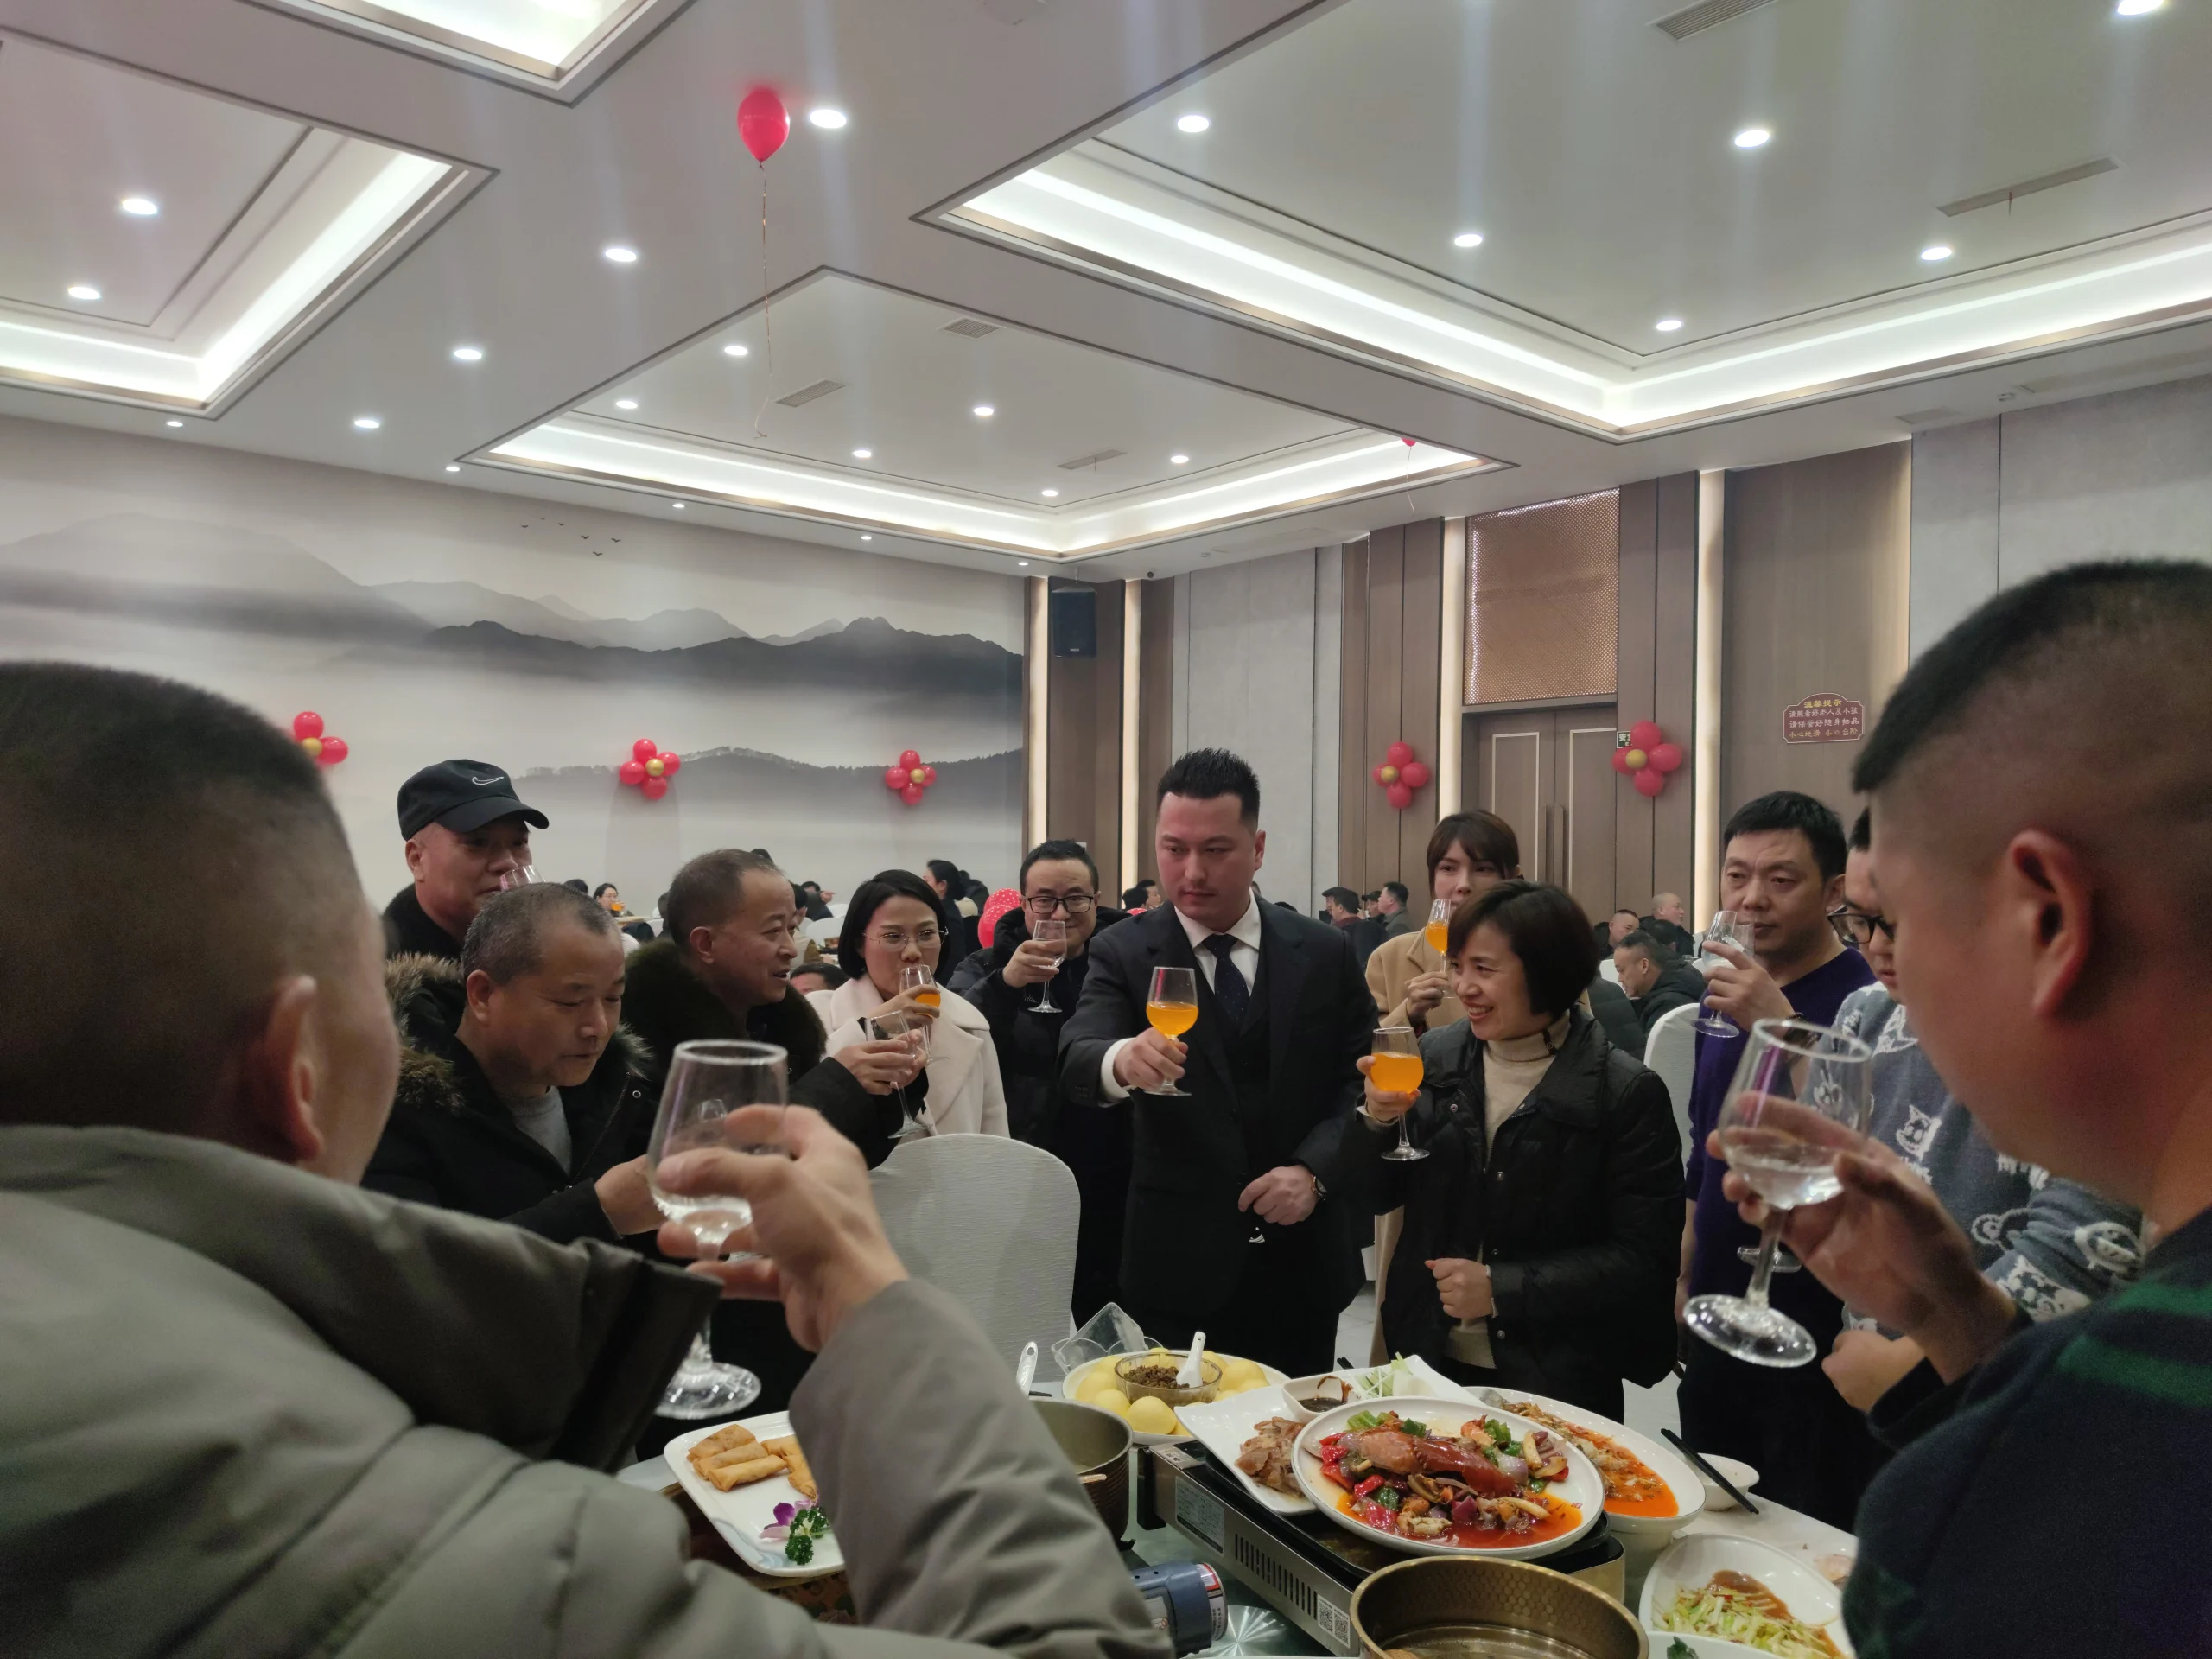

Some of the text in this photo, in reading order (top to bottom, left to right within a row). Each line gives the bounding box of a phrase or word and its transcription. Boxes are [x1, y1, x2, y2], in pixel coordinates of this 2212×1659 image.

[1803, 699, 1842, 709] 温馨提示
[1789, 707, 1858, 718] 请照看好老人及小孩
[1789, 718, 1859, 728] 请保管好随身物品
[1789, 728, 1858, 739] 小心地滑 小心台阶
